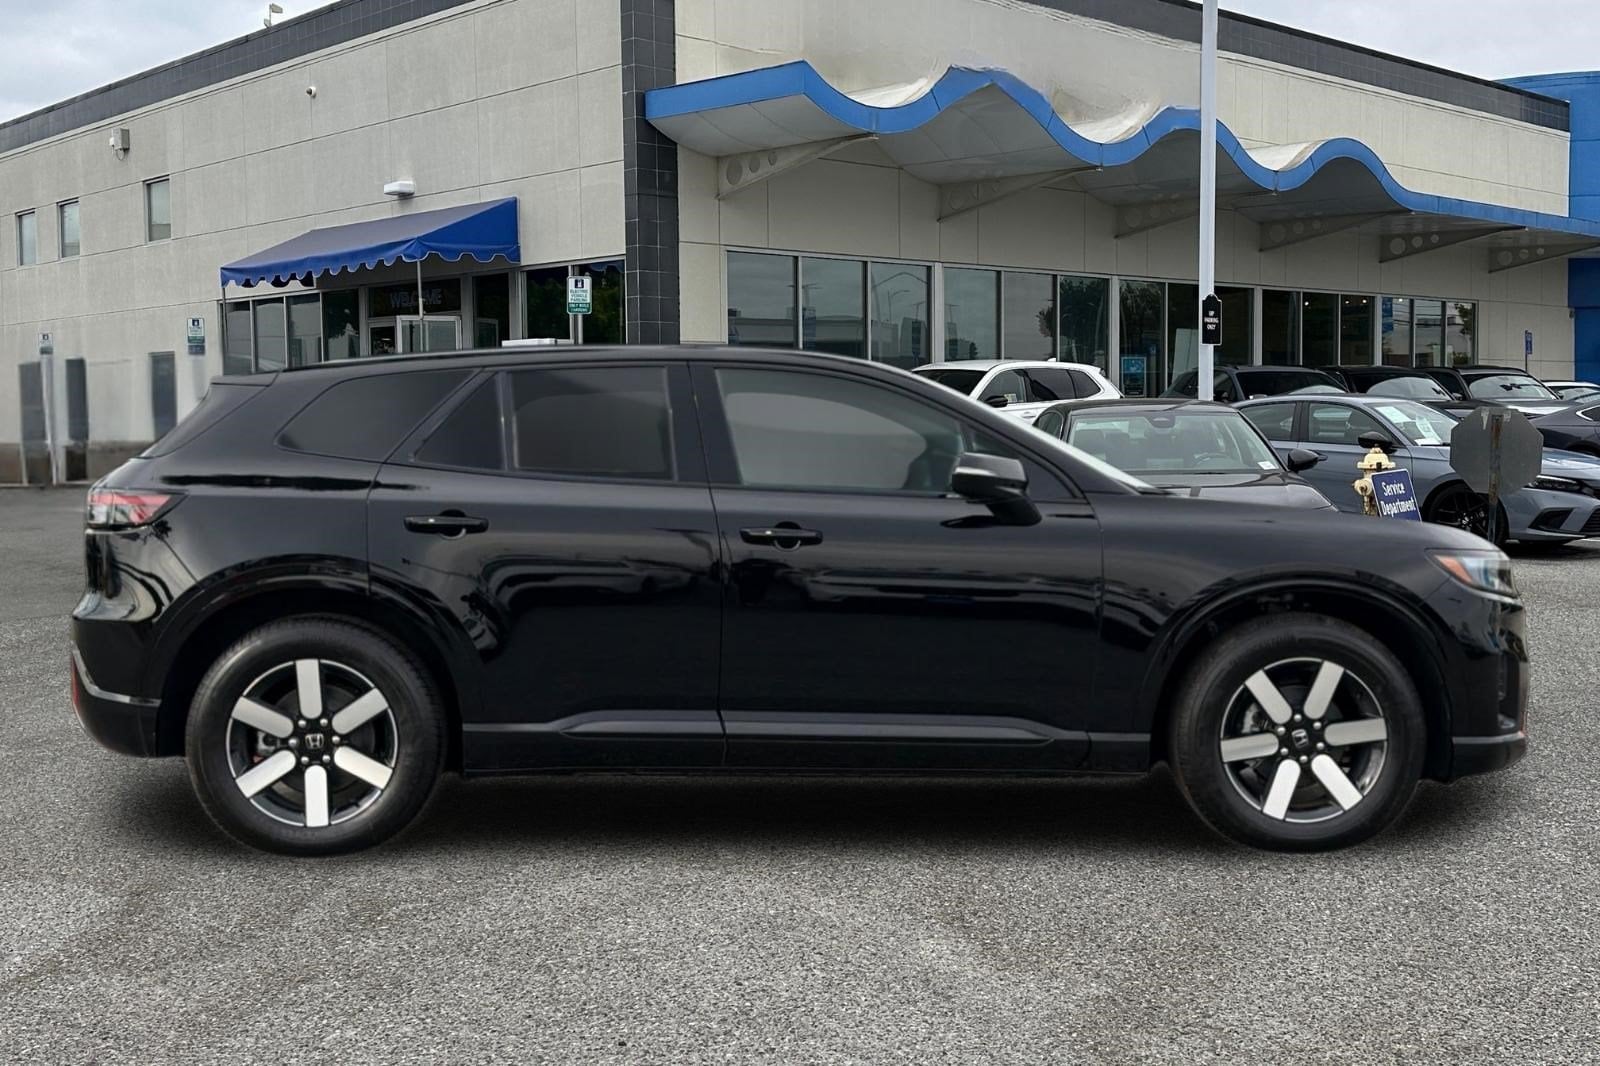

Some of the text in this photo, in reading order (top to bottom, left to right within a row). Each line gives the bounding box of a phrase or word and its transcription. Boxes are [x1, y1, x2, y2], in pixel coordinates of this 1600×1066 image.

[390, 288, 441, 308] WELCME
[1381, 480, 1406, 496] Service
[1380, 496, 1417, 518] Department
